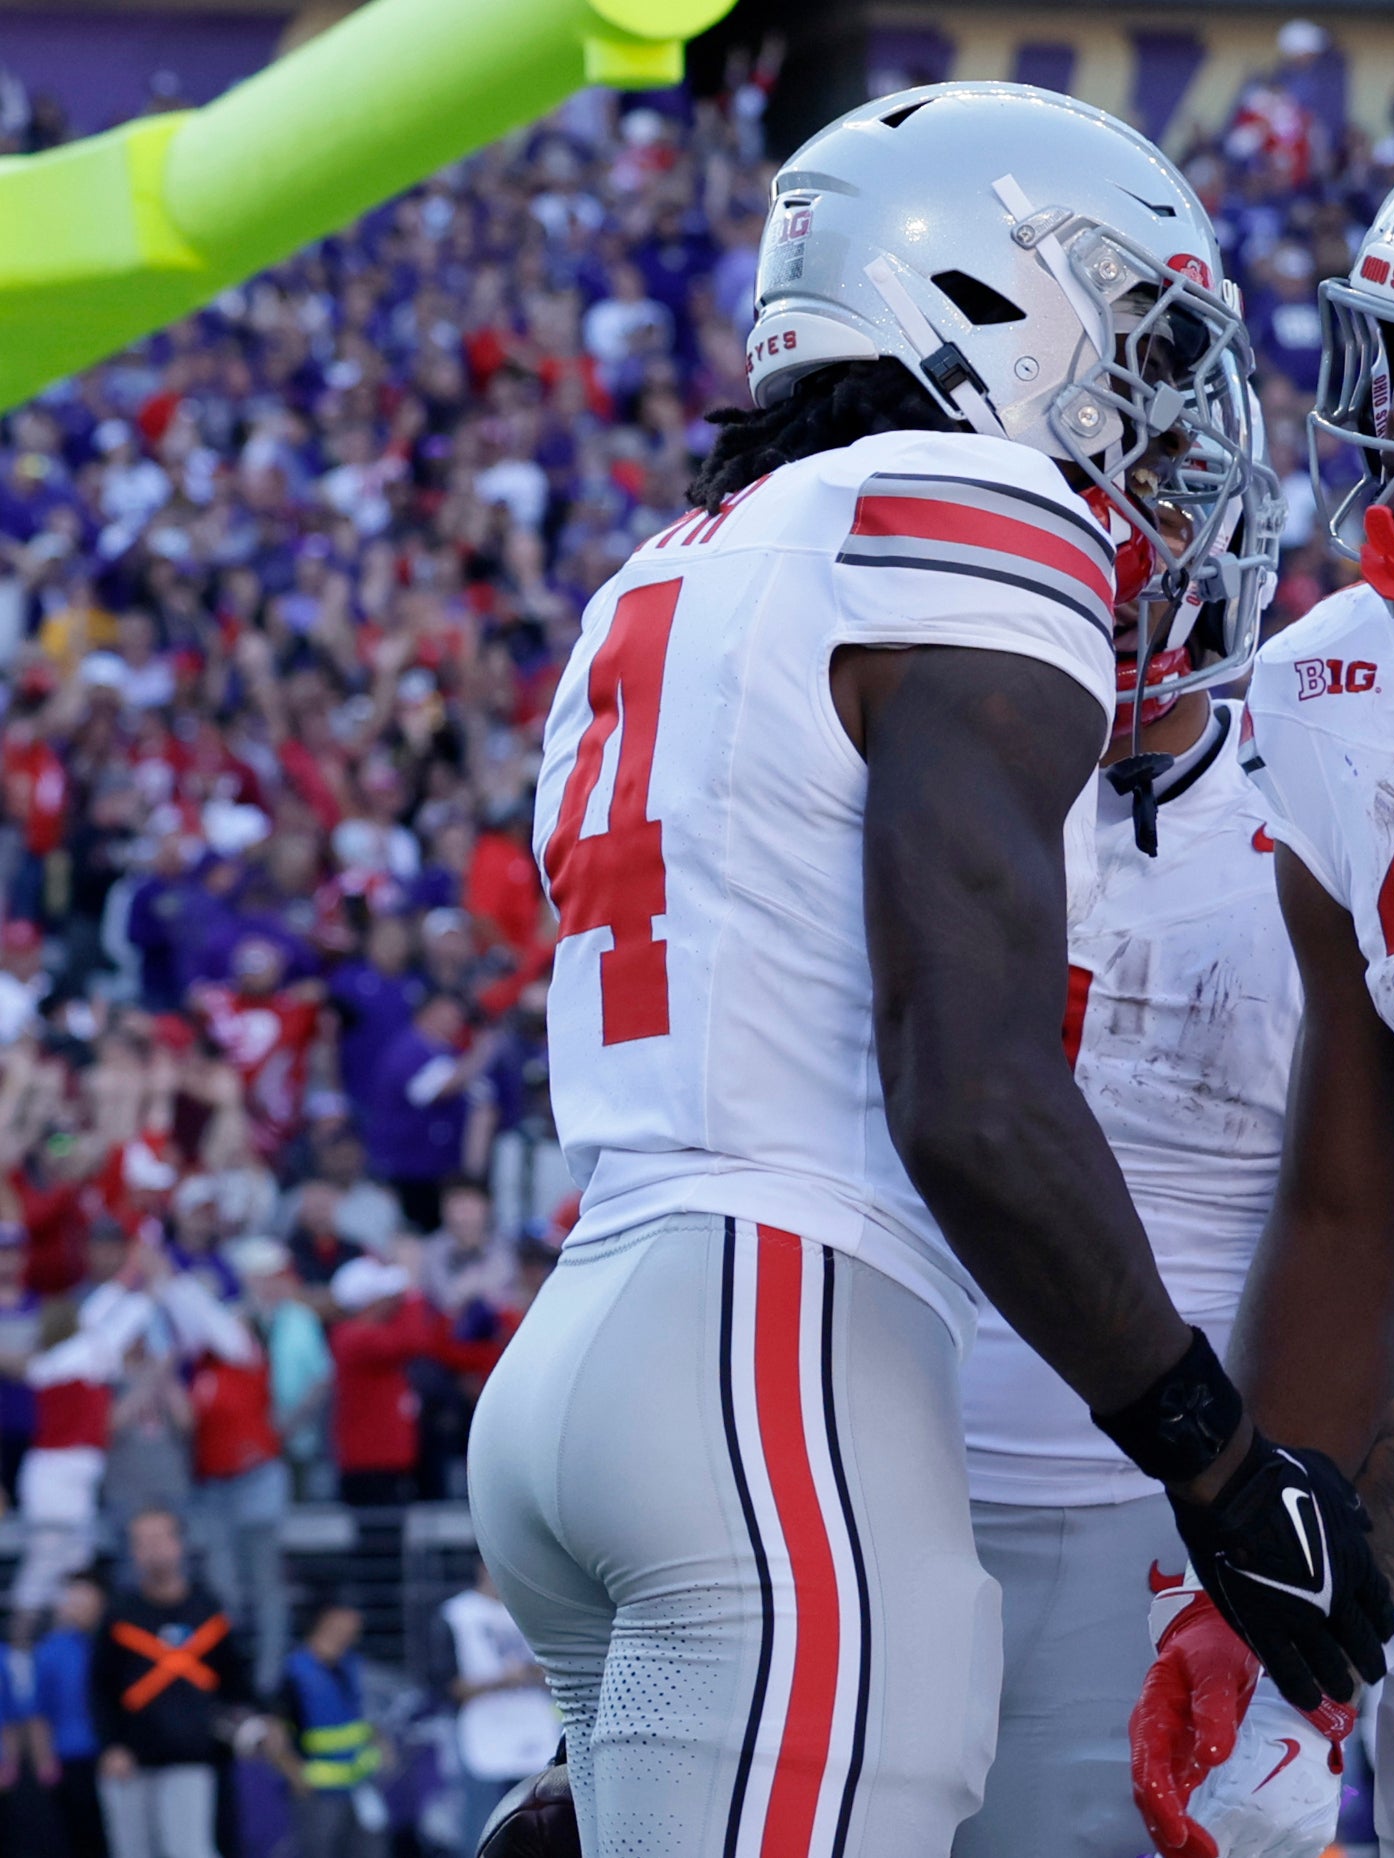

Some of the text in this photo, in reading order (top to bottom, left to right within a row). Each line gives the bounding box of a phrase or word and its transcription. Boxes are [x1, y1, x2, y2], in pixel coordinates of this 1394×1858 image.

[1360, 255, 1390, 285] OHIO
[1373, 374, 1389, 408] OHIO
[545, 577, 684, 1047] 4
